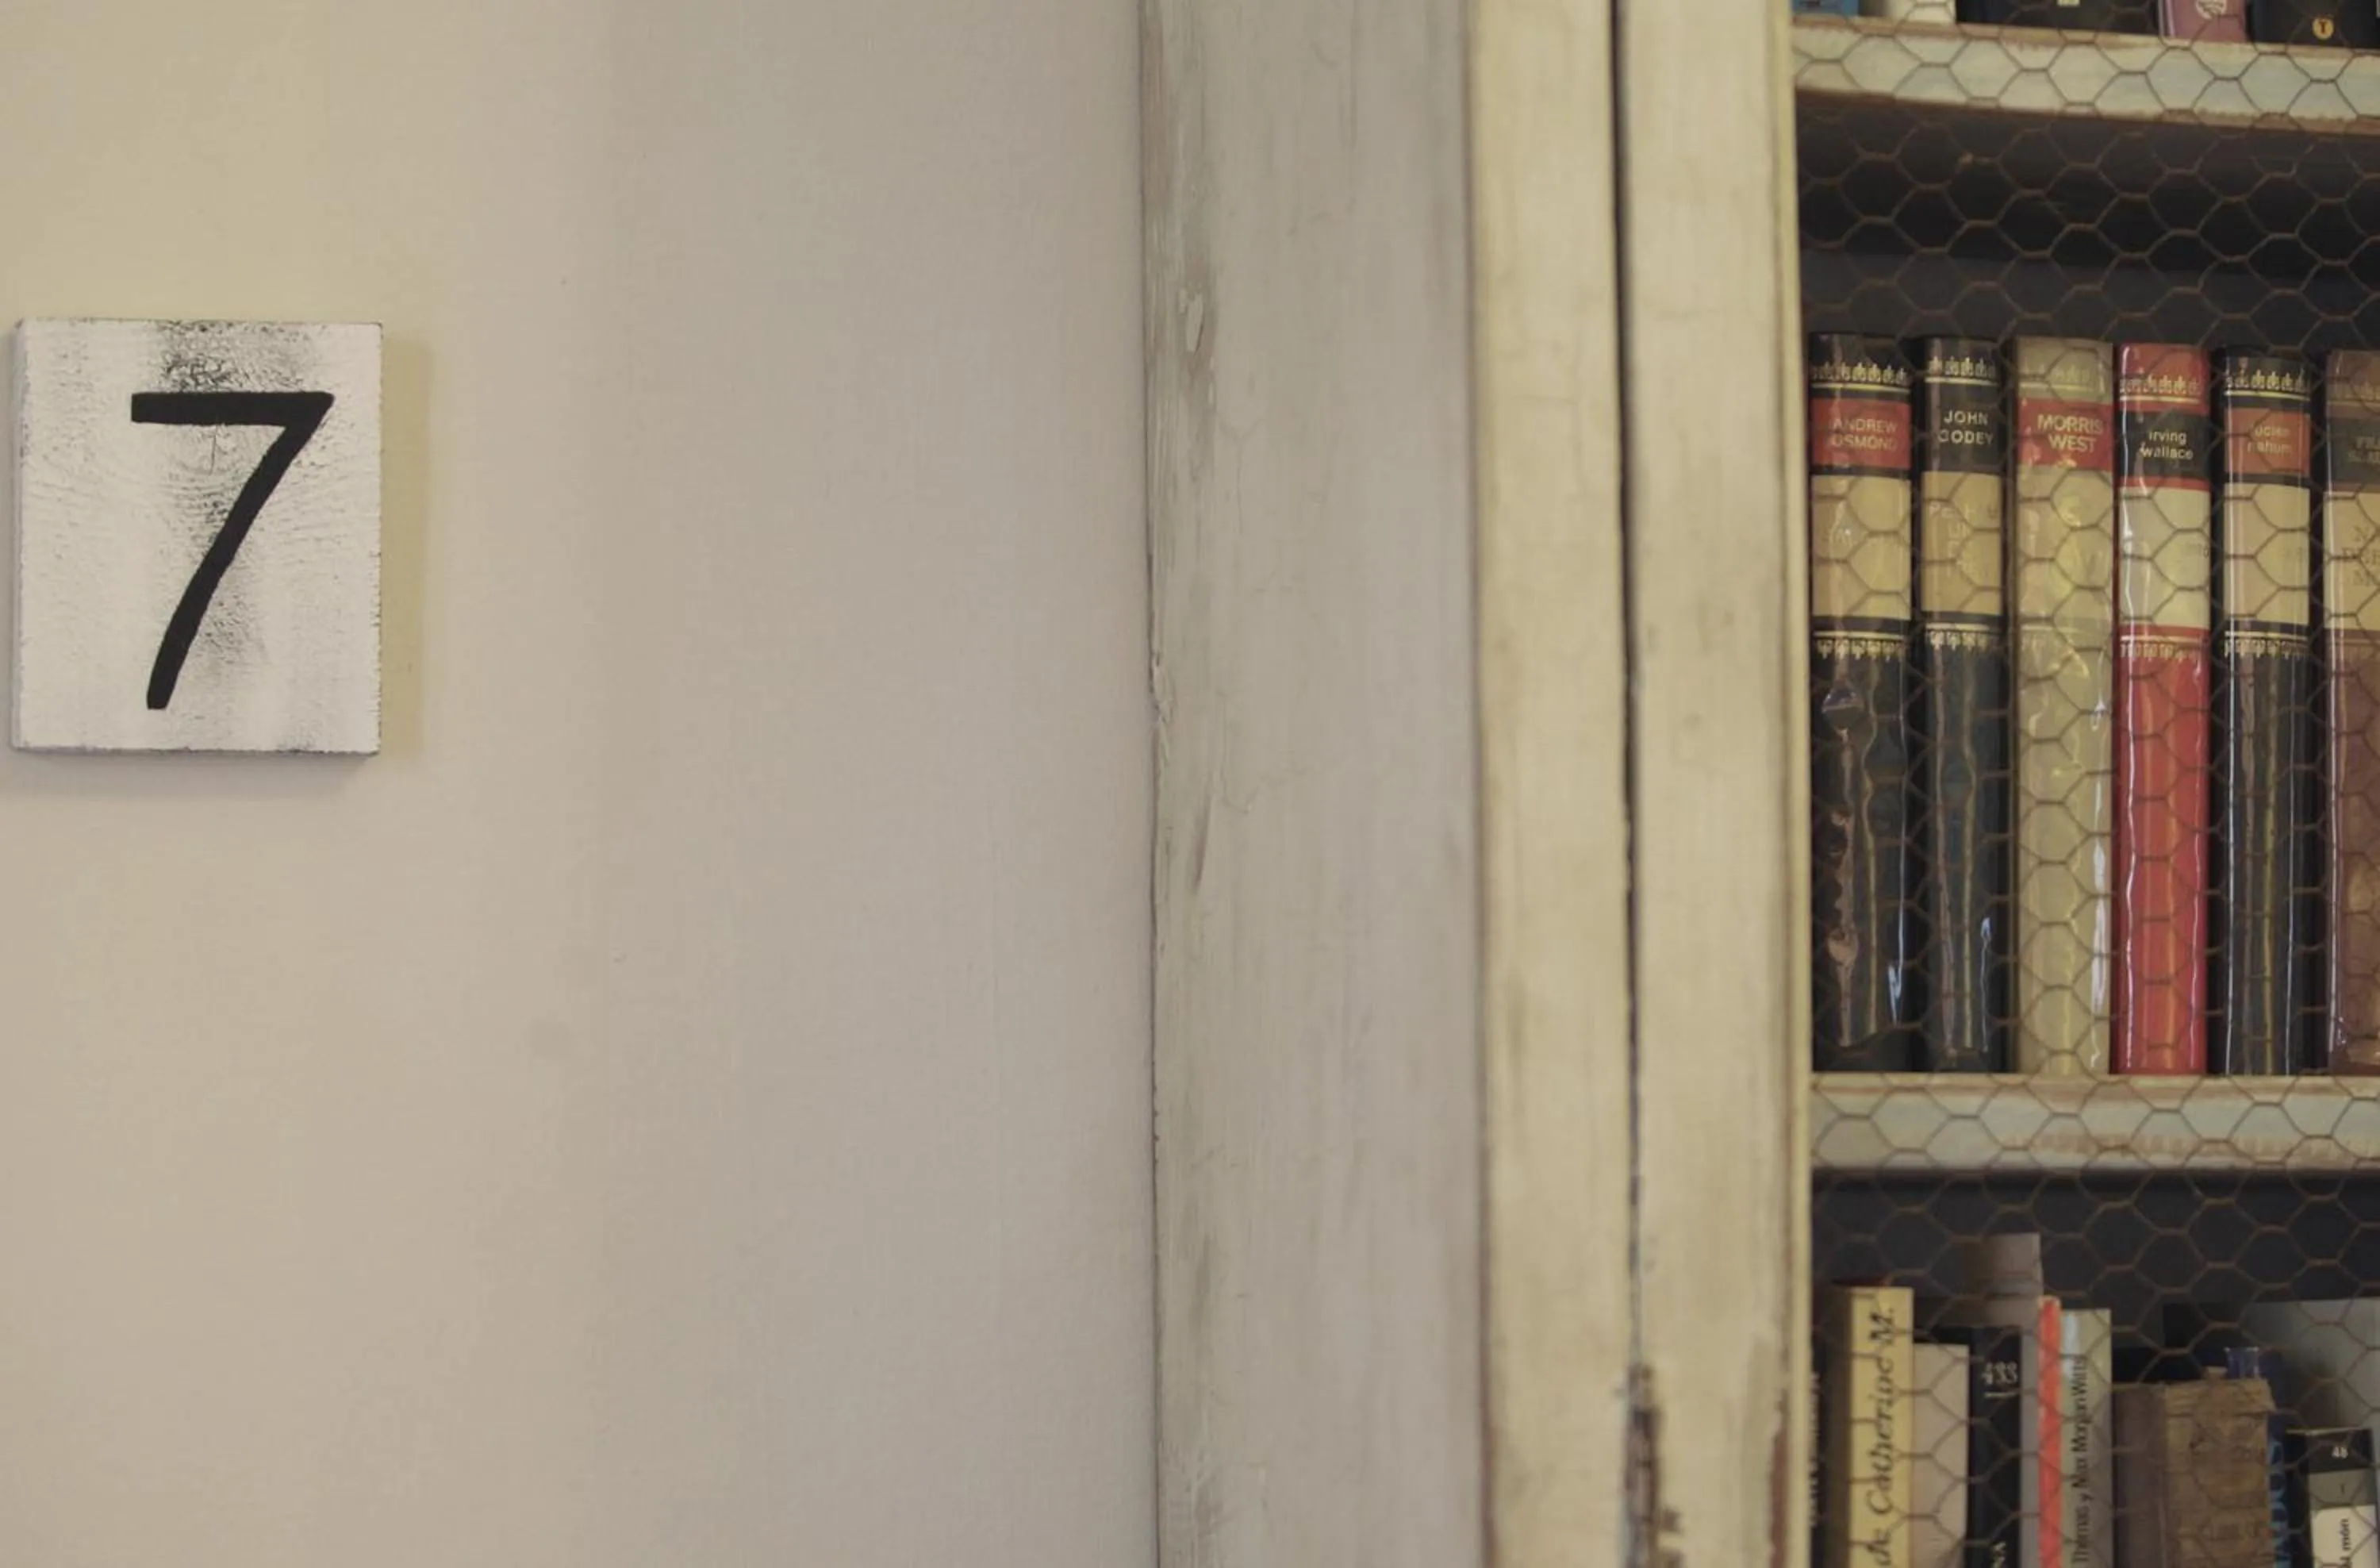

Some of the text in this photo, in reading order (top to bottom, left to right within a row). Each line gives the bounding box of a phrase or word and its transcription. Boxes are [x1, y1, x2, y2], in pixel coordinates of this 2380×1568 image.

[1833, 417, 1898, 434] ANDREW
[1944, 409, 1988, 425] JOHN
[2036, 413, 2103, 435] MORRIS
[1831, 432, 1898, 452] OSMOND
[2048, 433, 2097, 453] WEST
[131, 391, 335, 709] 7
